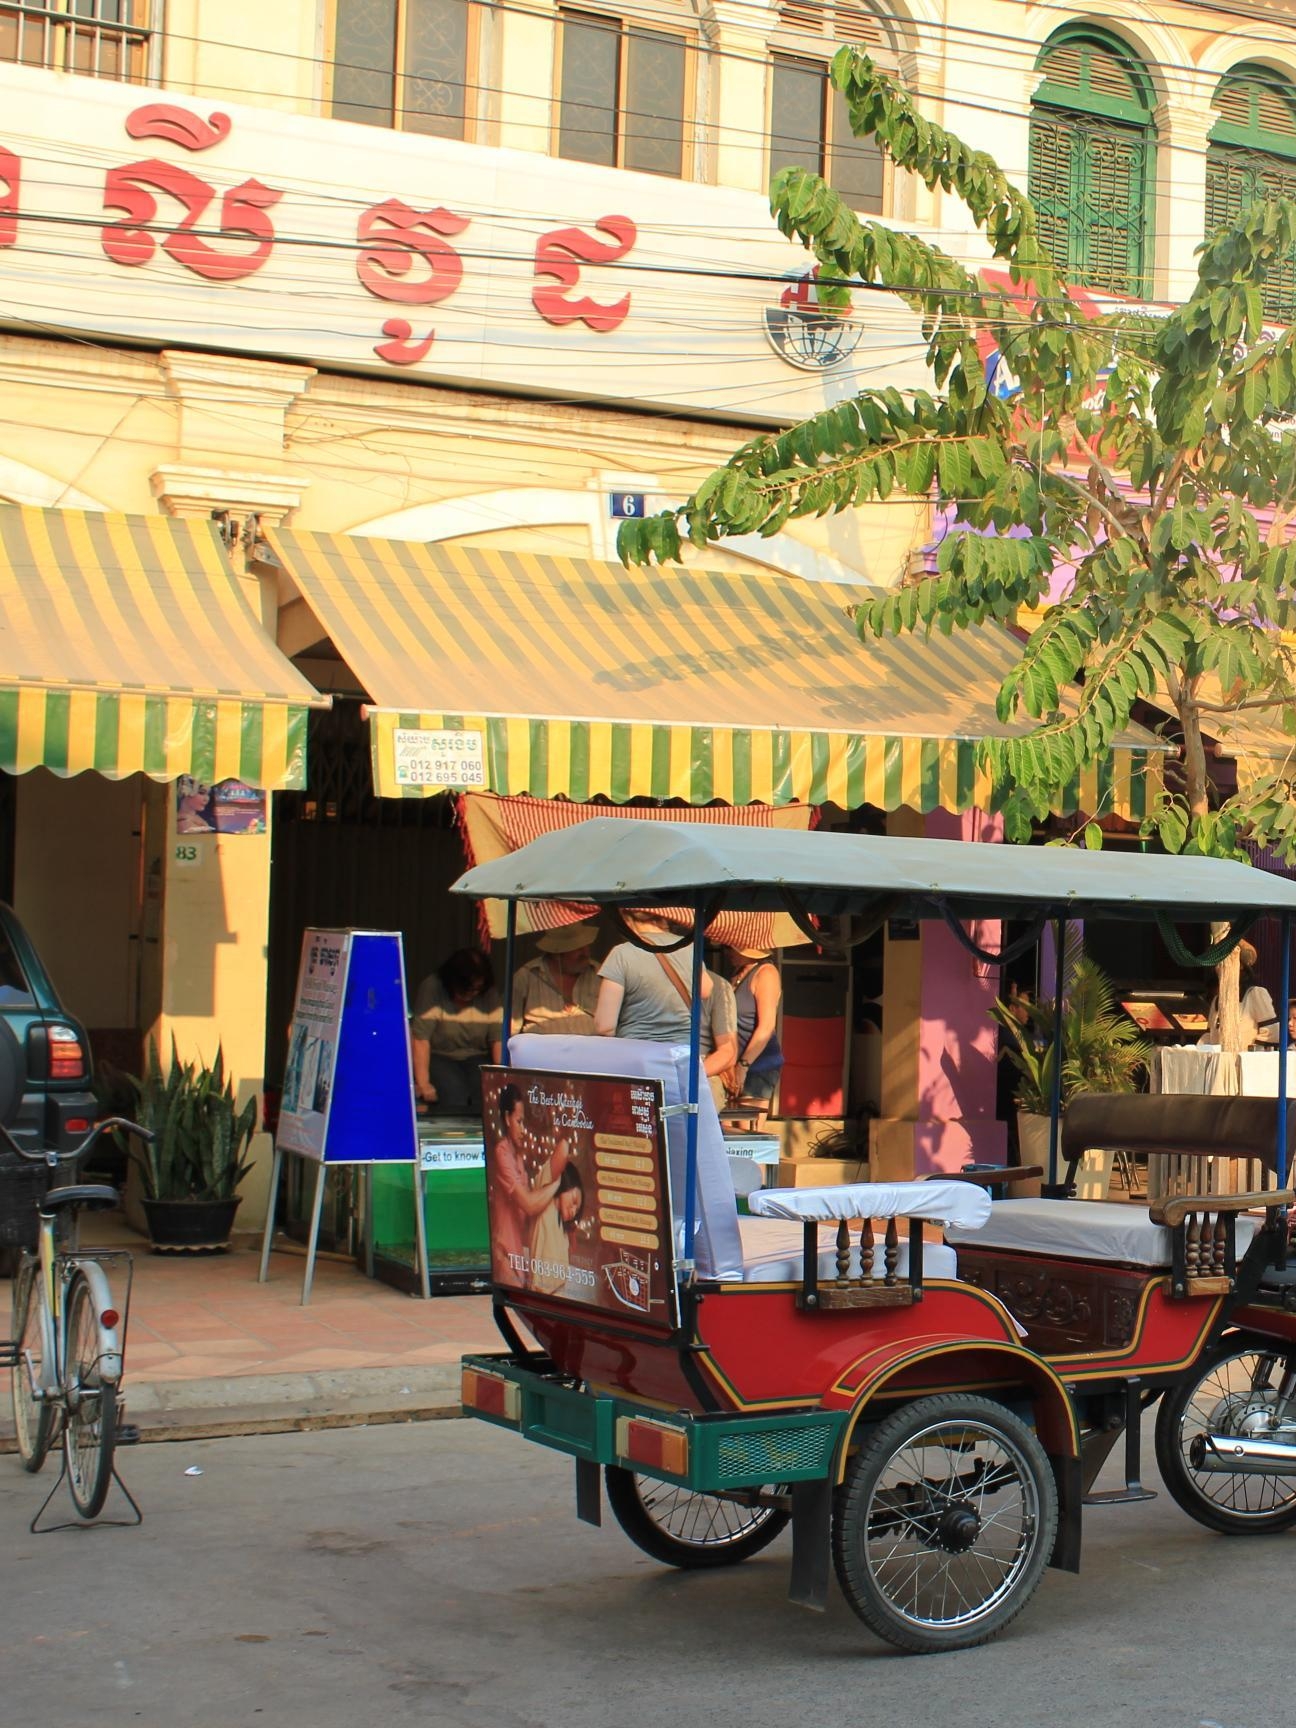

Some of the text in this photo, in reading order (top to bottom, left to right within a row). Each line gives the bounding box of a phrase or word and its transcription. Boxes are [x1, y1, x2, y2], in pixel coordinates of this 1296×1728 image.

[623, 495, 635, 517] 6
[410, 760, 482, 771] 012 917 060
[410, 772, 432, 782] 012
[461, 772, 483, 783] 045
[176, 846, 197, 861] 83
[444, 1153, 453, 1162] to
[455, 1151, 479, 1161] know
